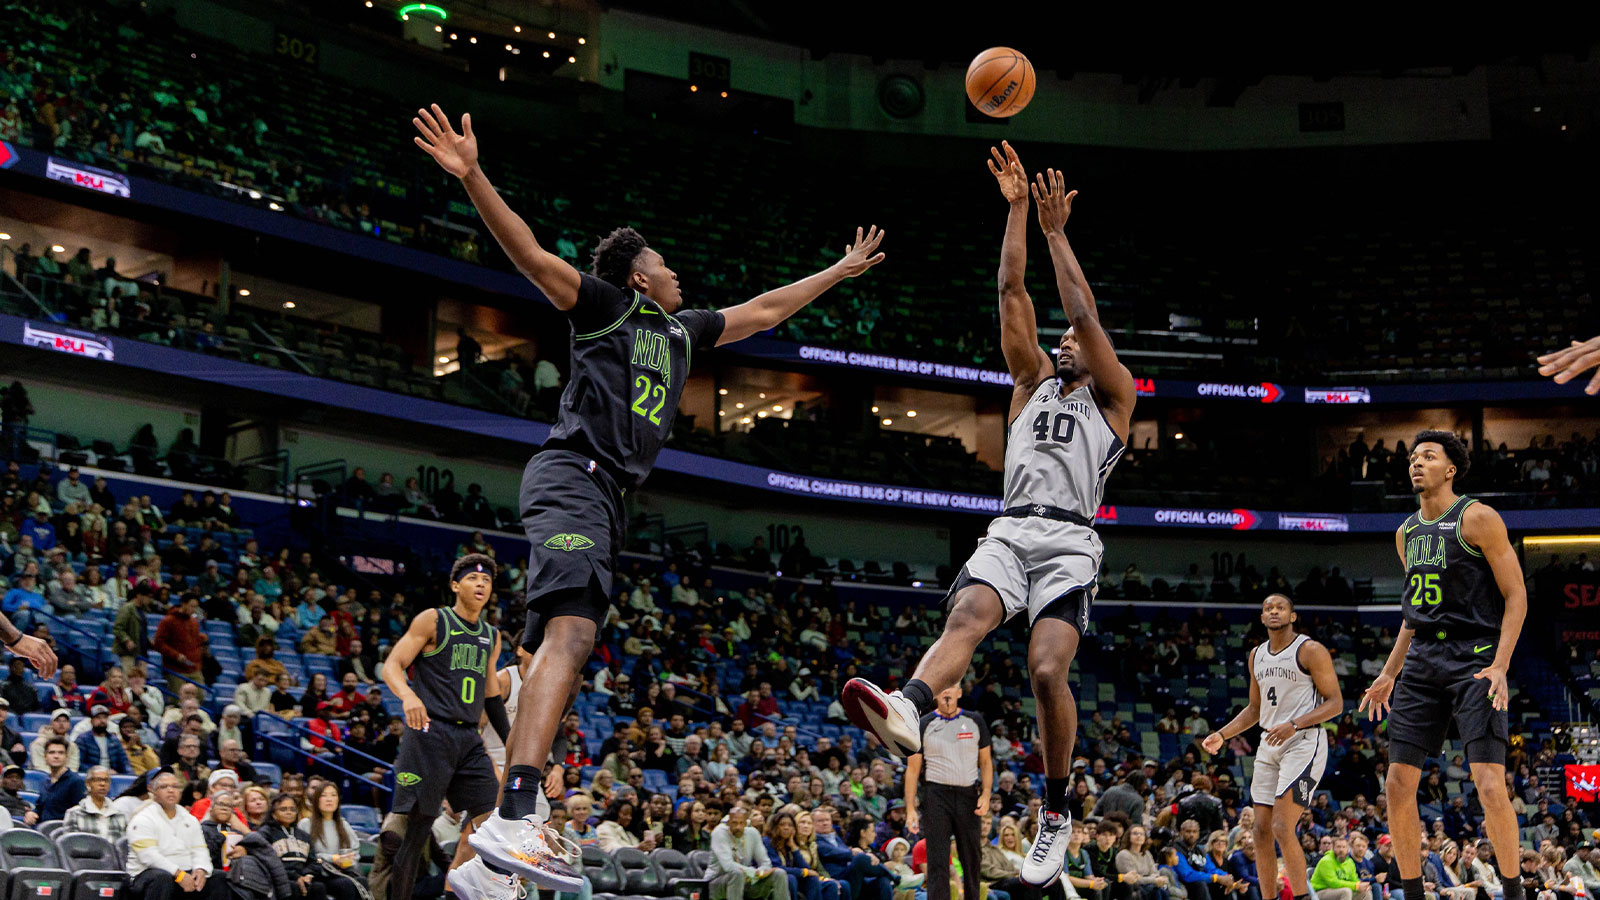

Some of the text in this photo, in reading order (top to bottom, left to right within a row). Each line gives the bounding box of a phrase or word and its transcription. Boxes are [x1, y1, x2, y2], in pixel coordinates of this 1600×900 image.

[275, 33, 317, 64] 302
[799, 346, 848, 364] OFFICIAL
[848, 352, 898, 371] CHARTER
[898, 358, 918, 373] BUS
[918, 361, 935, 374] OF
[935, 363, 954, 378] THE
[954, 366, 979, 381] NEW
[631, 375, 666, 426] 22
[1197, 383, 1246, 398] OFFICIAL
[1032, 411, 1077, 443] 40
[767, 472, 811, 492] OFFICIAL
[811, 480, 861, 499] CHARTER
[861, 486, 884, 500] BUS
[885, 488, 901, 502] OF
[901, 490, 923, 504] THE
[923, 492, 950, 507] NEW
[950, 494, 999, 512] ORLEANS
[1154, 510, 1207, 525] OFFICIAL
[1405, 534, 1447, 572] NOLA
[1410, 573, 1442, 606] 25
[450, 643, 488, 679] NOLA
[1265, 666, 1297, 682] ANTONIO
[461, 676, 476, 704] 0
[1266, 686, 1278, 706] 4
